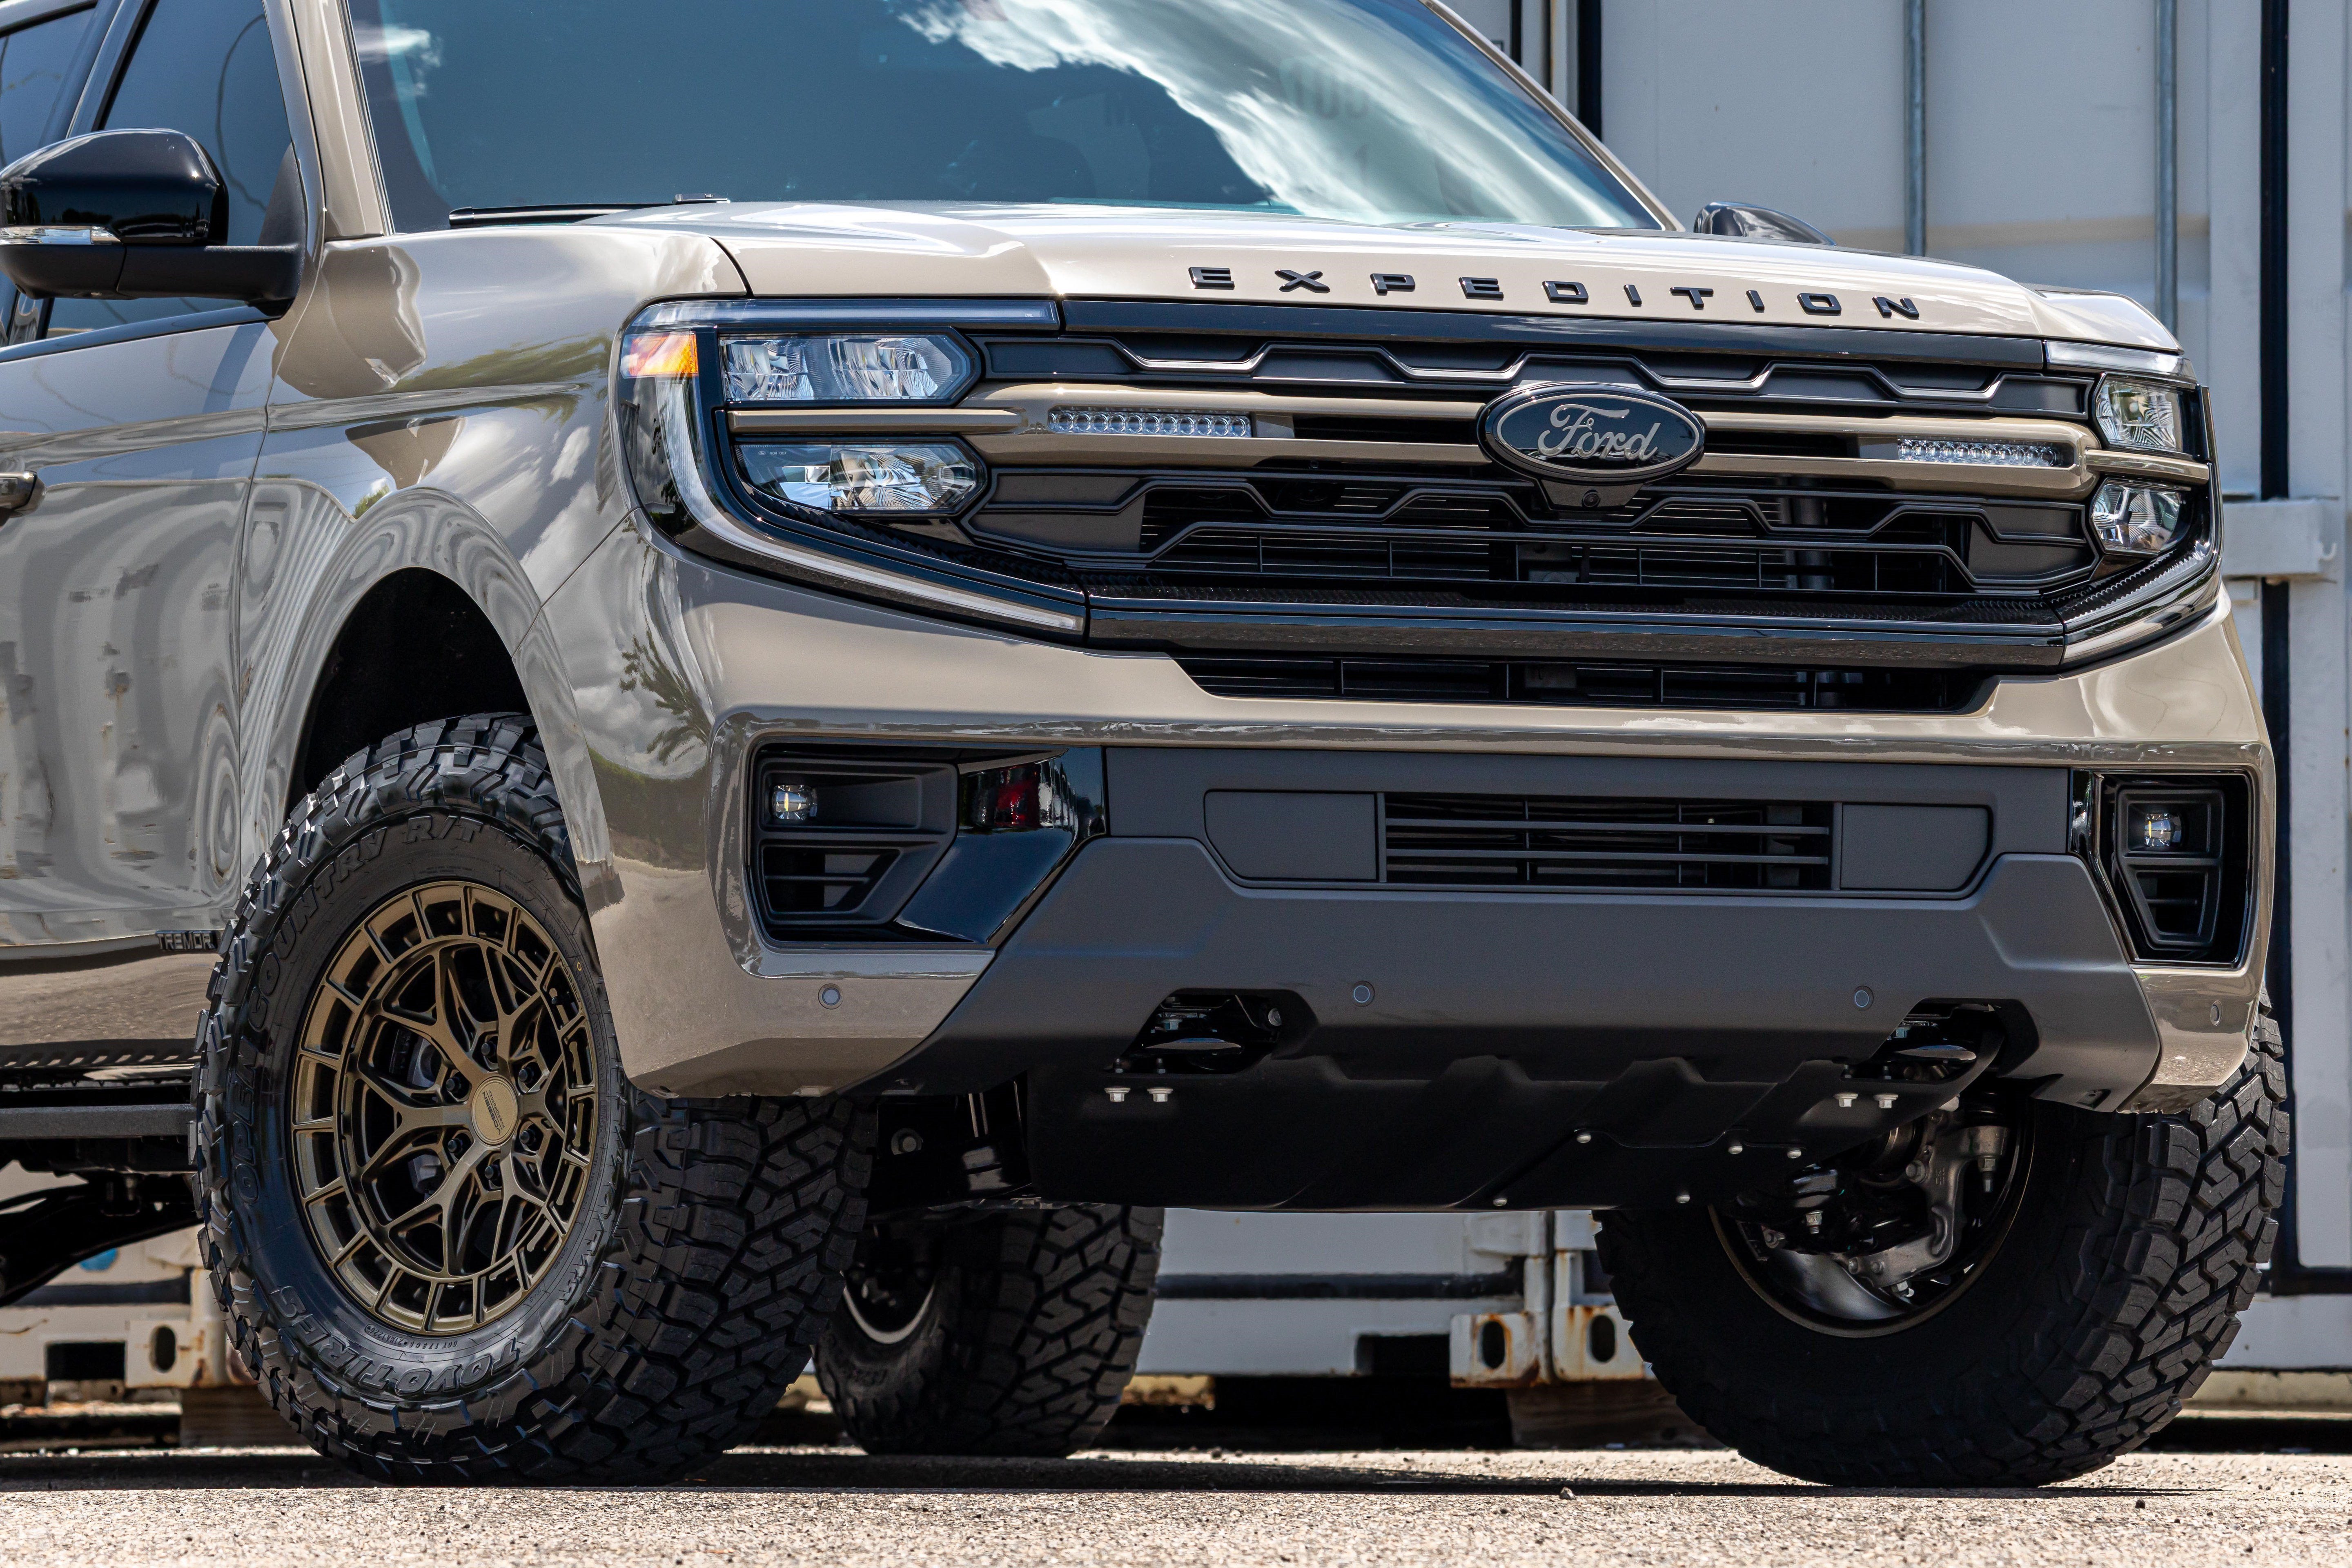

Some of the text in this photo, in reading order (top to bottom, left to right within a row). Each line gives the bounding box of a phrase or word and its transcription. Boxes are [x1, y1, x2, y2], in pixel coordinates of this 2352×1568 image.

[1188, 266, 1920, 320] EXPEDITION
[1536, 403, 1662, 462] Ford
[156, 931, 216, 950] TREMOR
[232, 1036, 259, 1204] OPEN
[249, 826, 387, 1029] COUNTRY
[405, 815, 483, 844] R/T
[482, 1091, 501, 1135] VOSSEN
[271, 1285, 521, 1395] TOYO TIRES
[442, 1340, 458, 1349] DOT
